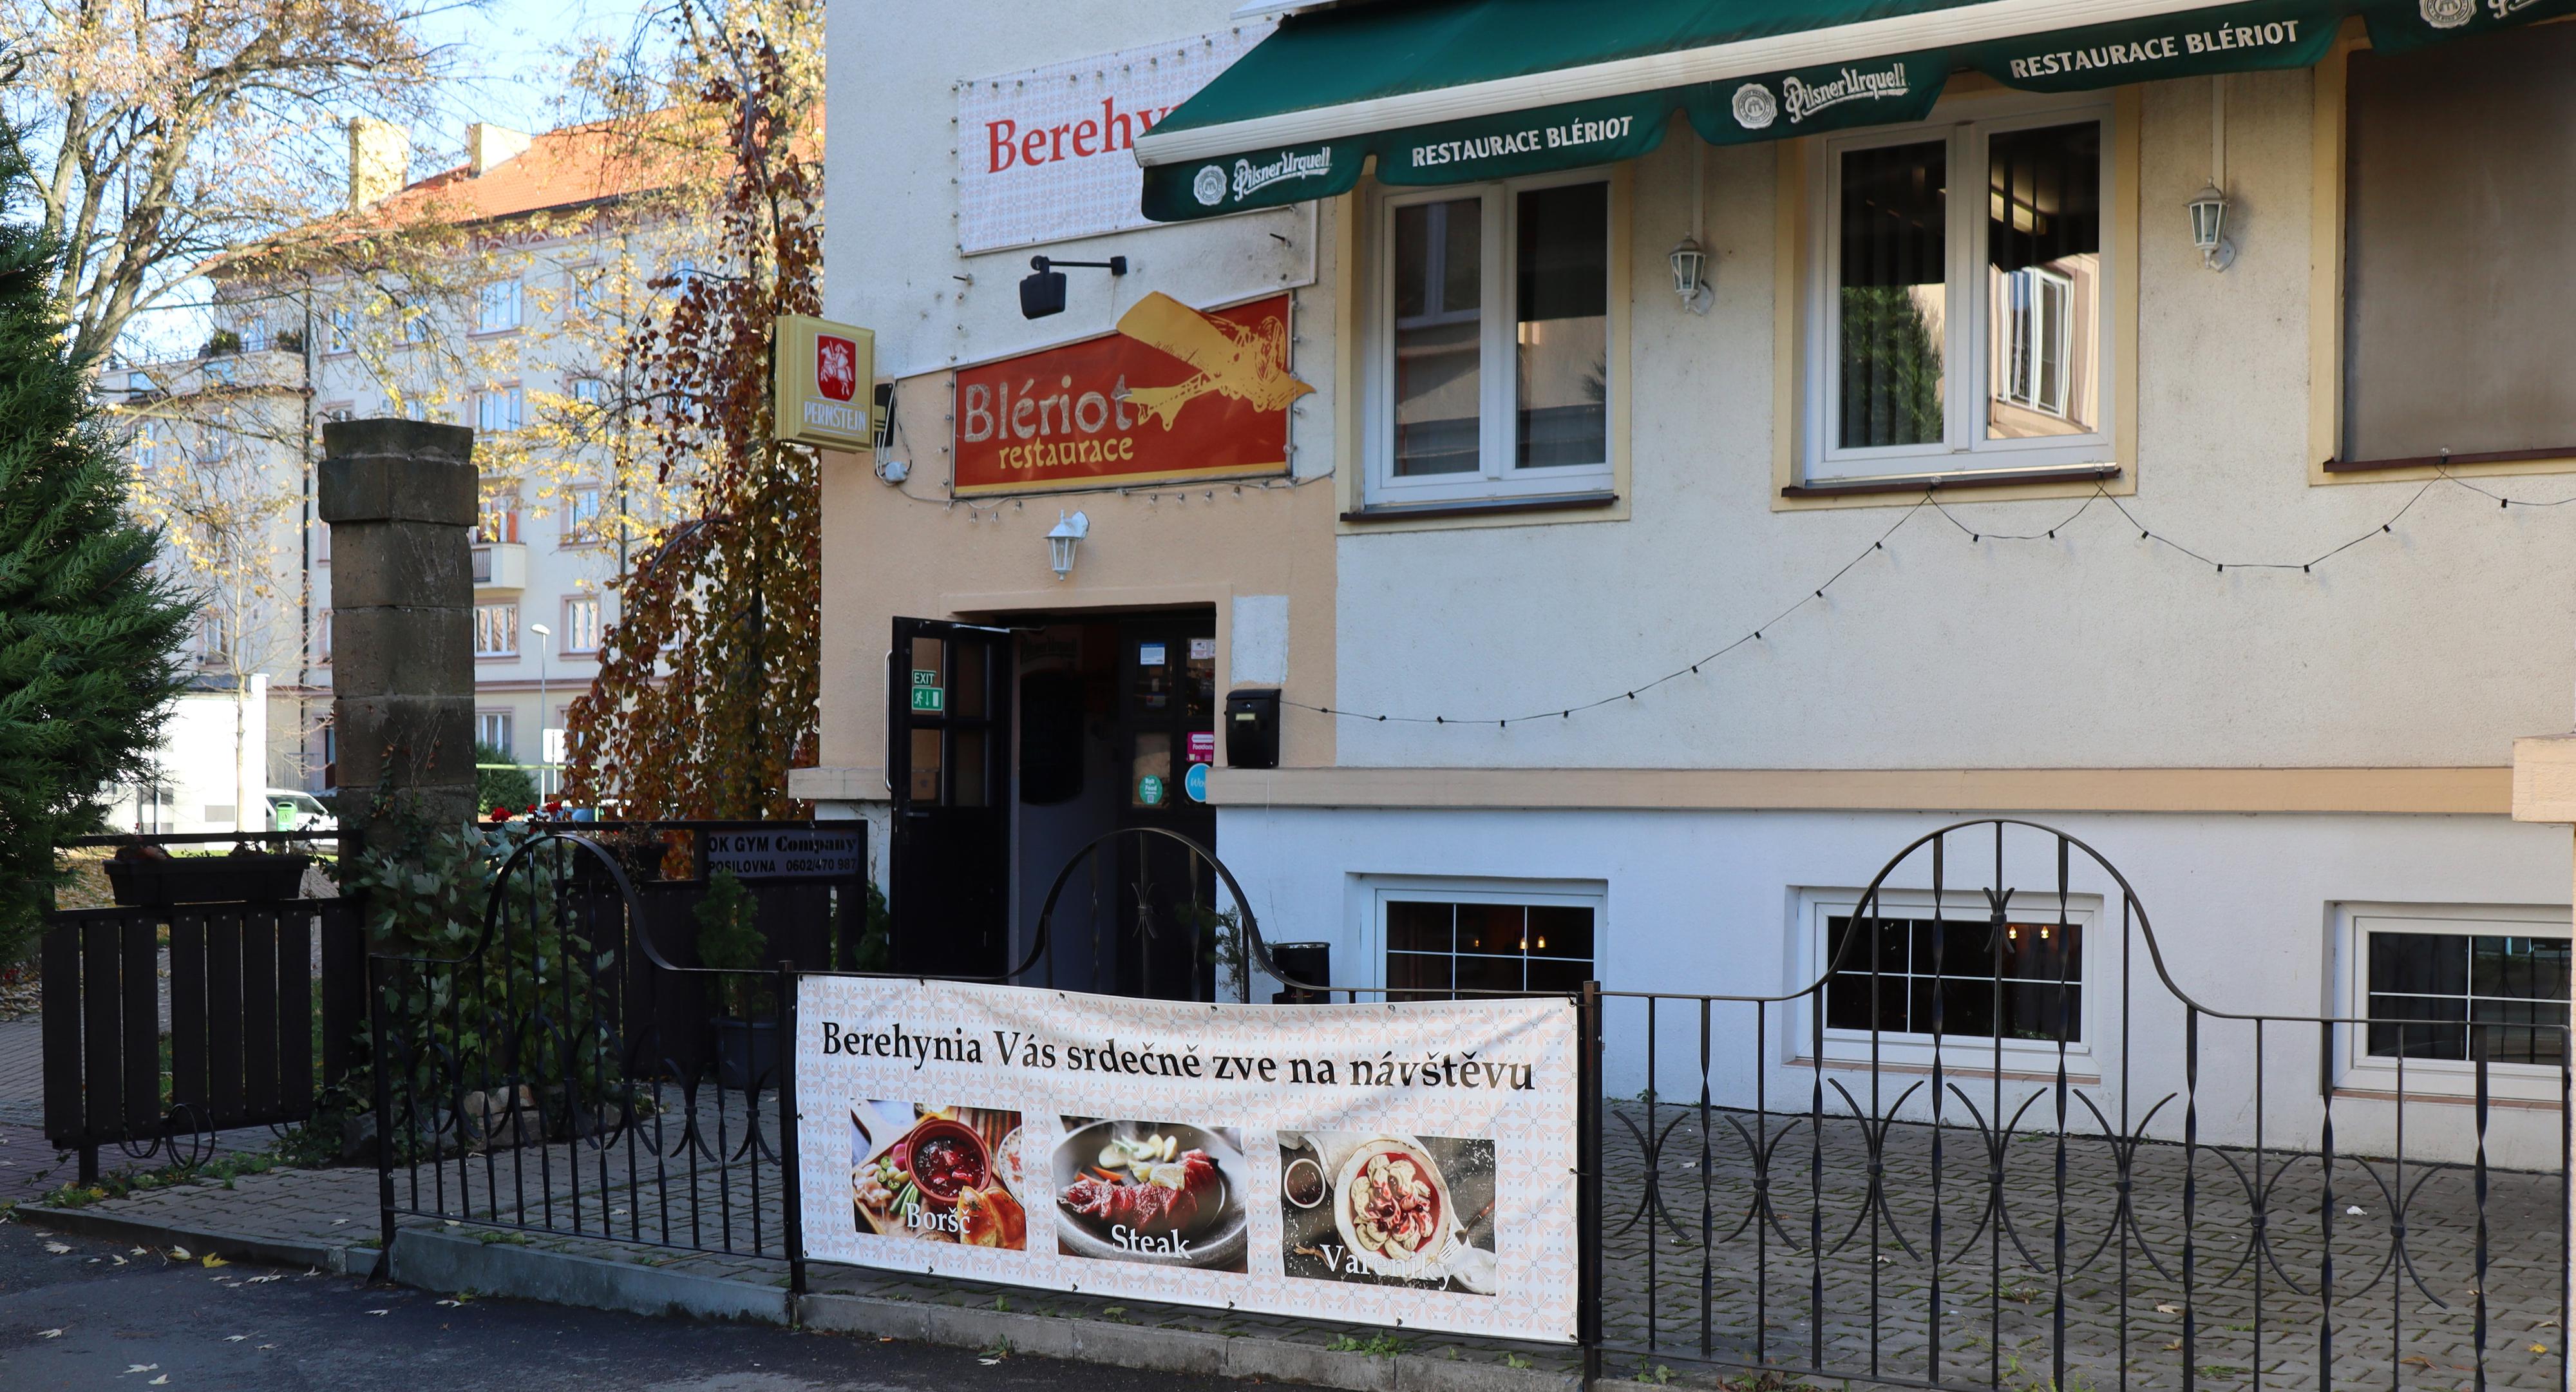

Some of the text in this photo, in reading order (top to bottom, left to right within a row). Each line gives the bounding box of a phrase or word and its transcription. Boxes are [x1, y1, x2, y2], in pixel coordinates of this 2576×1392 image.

[2010, 20, 2299, 79] RESTAURACE BLÉRIOT
[1783, 76, 1846, 124] Pilsner
[1841, 62, 1906, 101] Urquell
[1412, 116, 1633, 167] RESTAURACE BLÉRIOT
[1233, 158, 1283, 202] Pilsner
[1282, 146, 1331, 180] Urquell
[804, 401, 866, 432] PERNŠTEJN
[964, 374, 1132, 443] Blériot
[999, 437, 1133, 469] restaurace
[914, 672, 934, 685] EXIT
[1190, 777, 1204, 787] Wo
[708, 835, 857, 854] OK GYM Company
[708, 858, 857, 873] POSILOVNA 0602/470 987
[822, 1022, 1535, 1091] Berehynia Vás srdečně zve na návštěvu
[906, 1202, 971, 1235] Boršč
[1111, 1224, 1193, 1261] Steak
[1320, 1243, 1455, 1291] Vareniky
